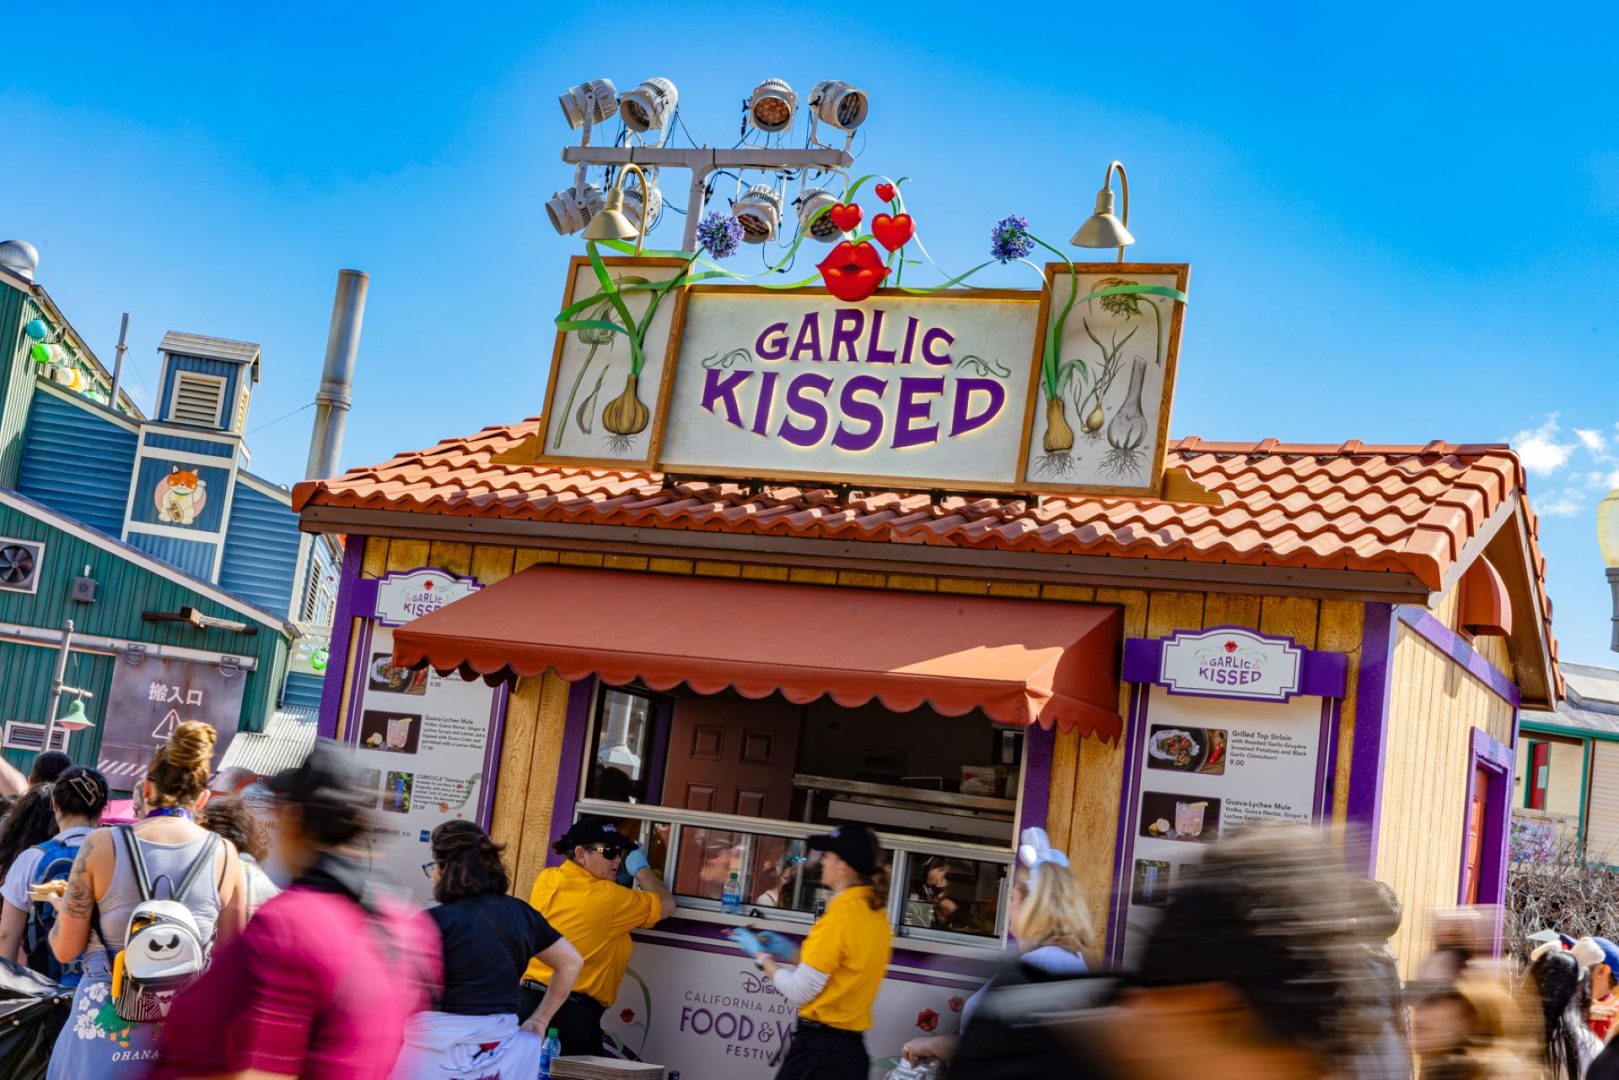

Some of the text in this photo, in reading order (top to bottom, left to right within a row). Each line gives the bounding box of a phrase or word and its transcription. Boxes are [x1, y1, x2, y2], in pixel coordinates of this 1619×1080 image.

[755, 308, 955, 366] GARLIC
[700, 367, 1005, 452] KISSED
[412, 593, 443, 604] GARLIC
[404, 603, 441, 616] KISS
[1210, 656, 1251, 669] GARLIC
[1199, 667, 1261, 685] KISSED
[148, 682, 203, 706] 搬入口
[1257, 732, 1268, 740] Top
[1226, 798, 1272, 808] Guava-Lychee
[684, 991, 762, 1012] CALIFORNIA
[680, 1006, 753, 1042] FOOD
[758, 1021, 774, 1043] &
[112, 1050, 159, 1061] OHANA
